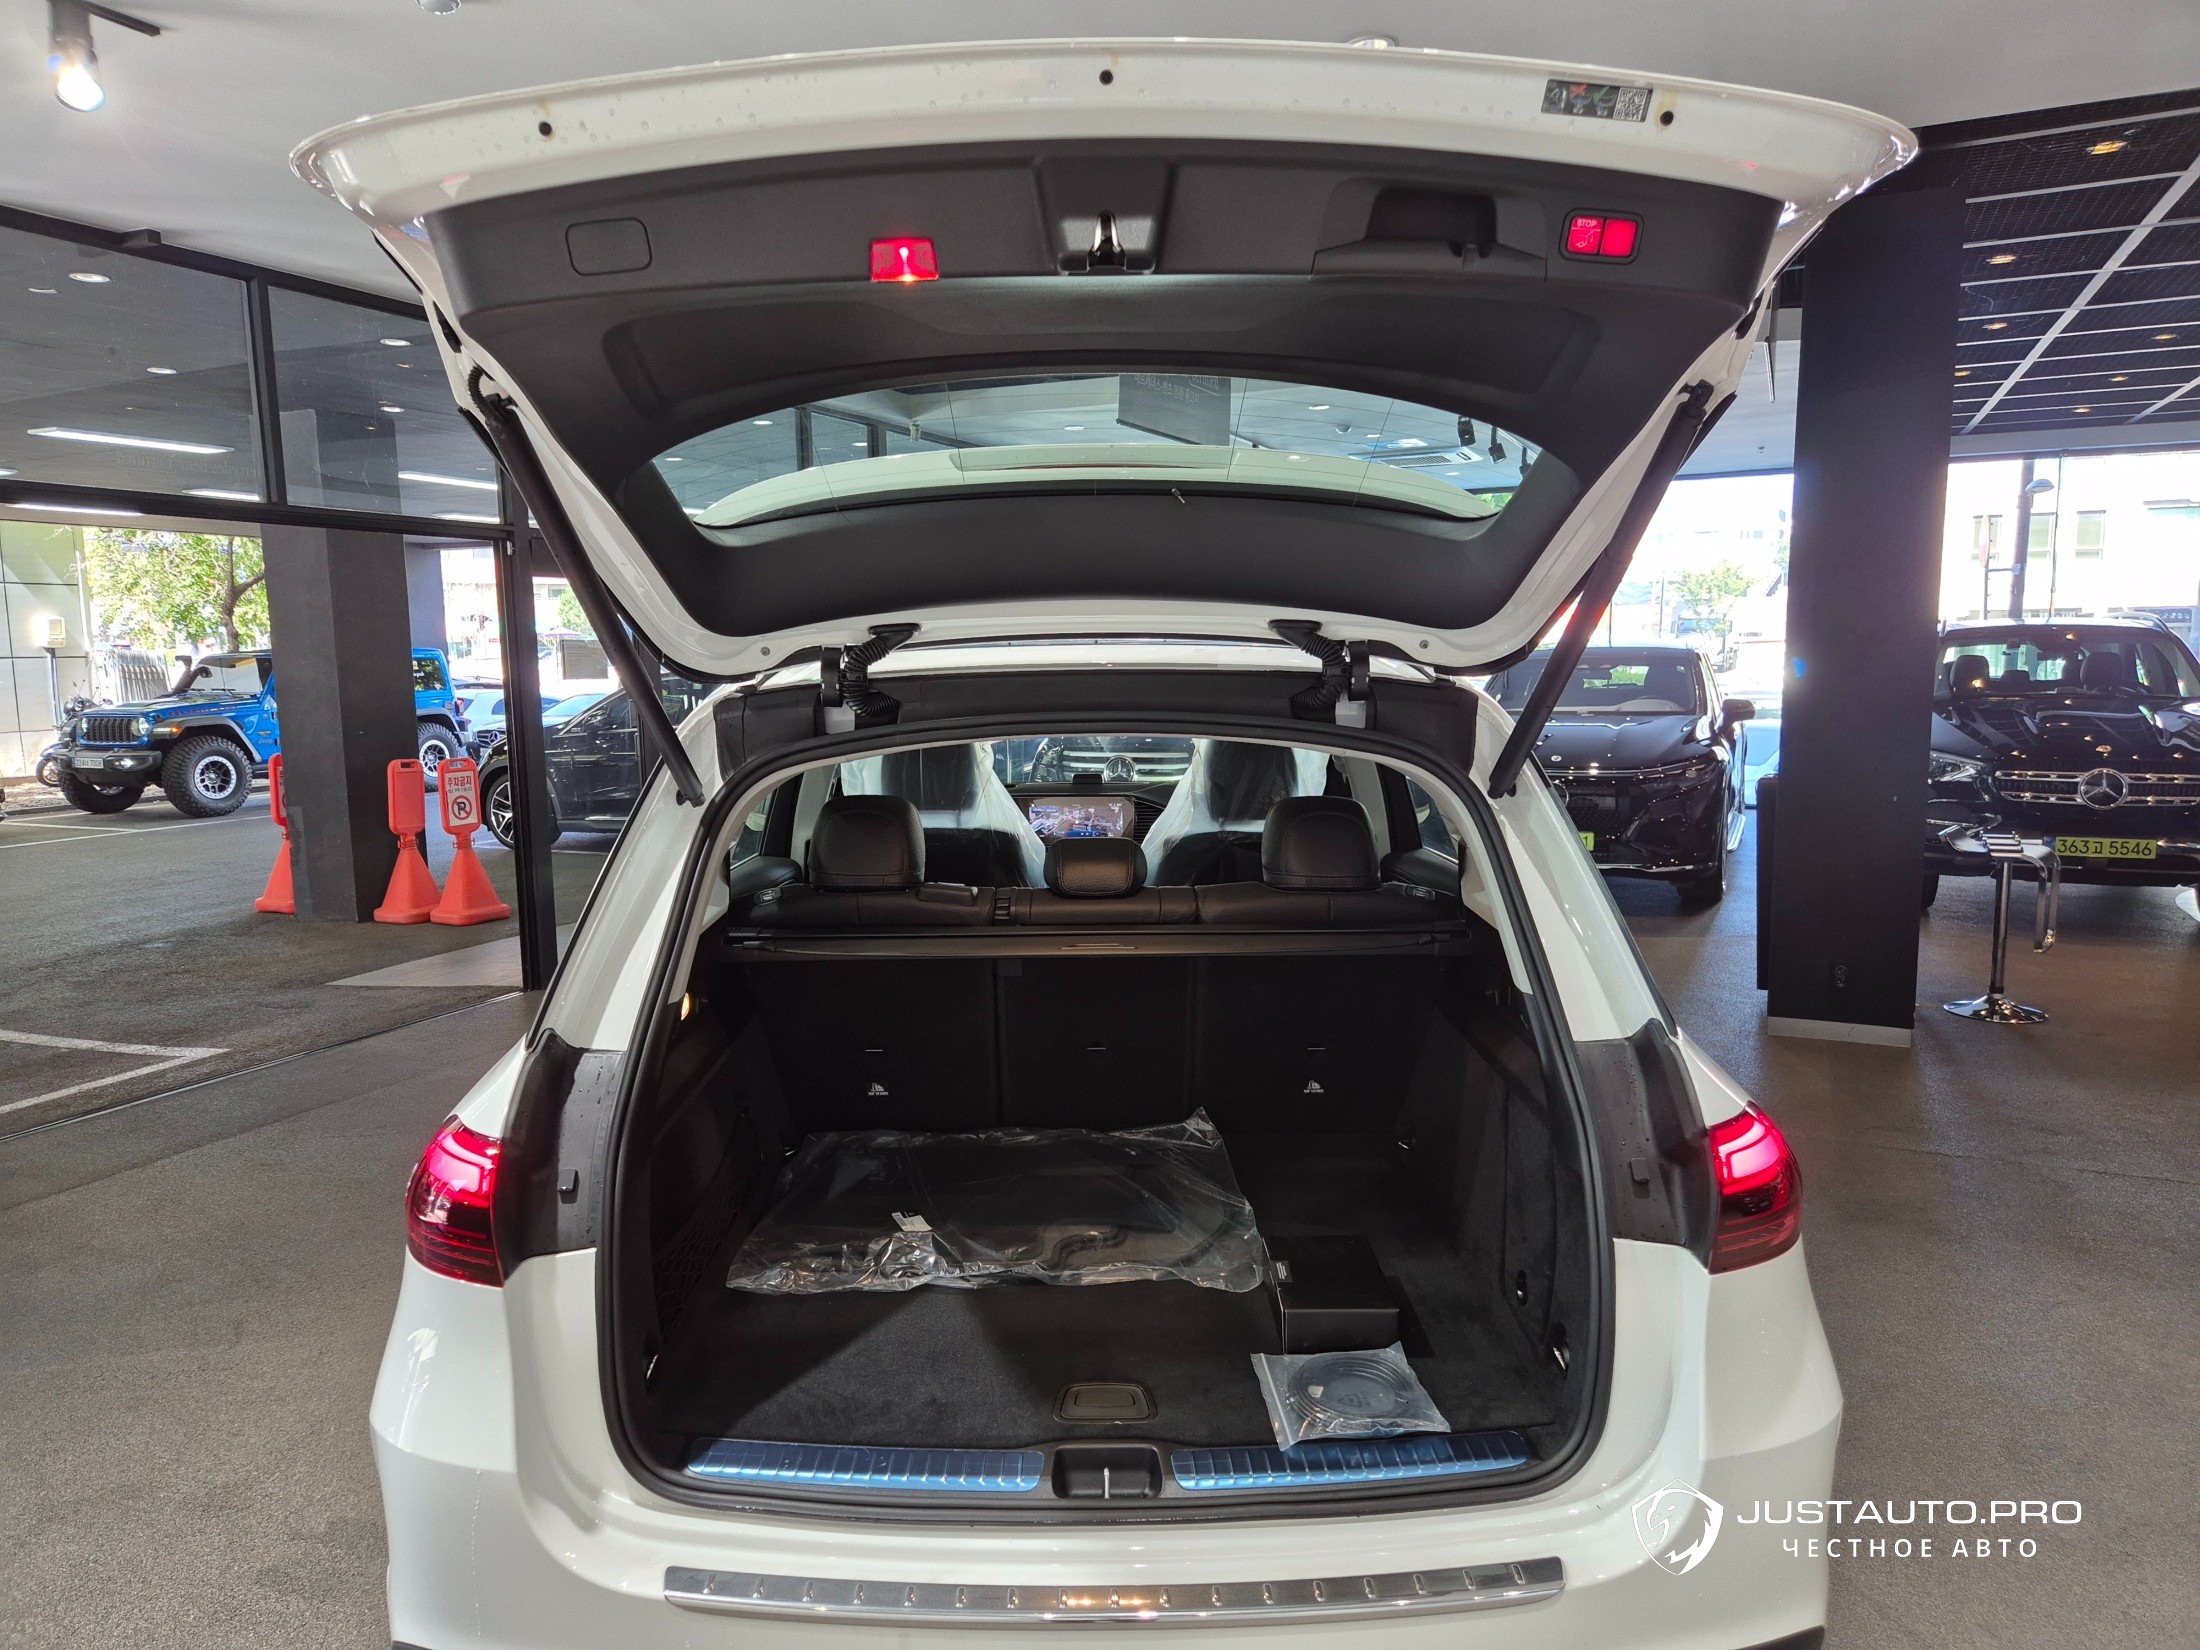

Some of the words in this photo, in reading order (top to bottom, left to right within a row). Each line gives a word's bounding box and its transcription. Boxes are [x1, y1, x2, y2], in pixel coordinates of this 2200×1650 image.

[1577, 218, 1597, 228] STOP
[447, 775, 472, 788] 주차금지
[2057, 839, 2103, 855] 363고
[2108, 841, 2152, 856] 5546
